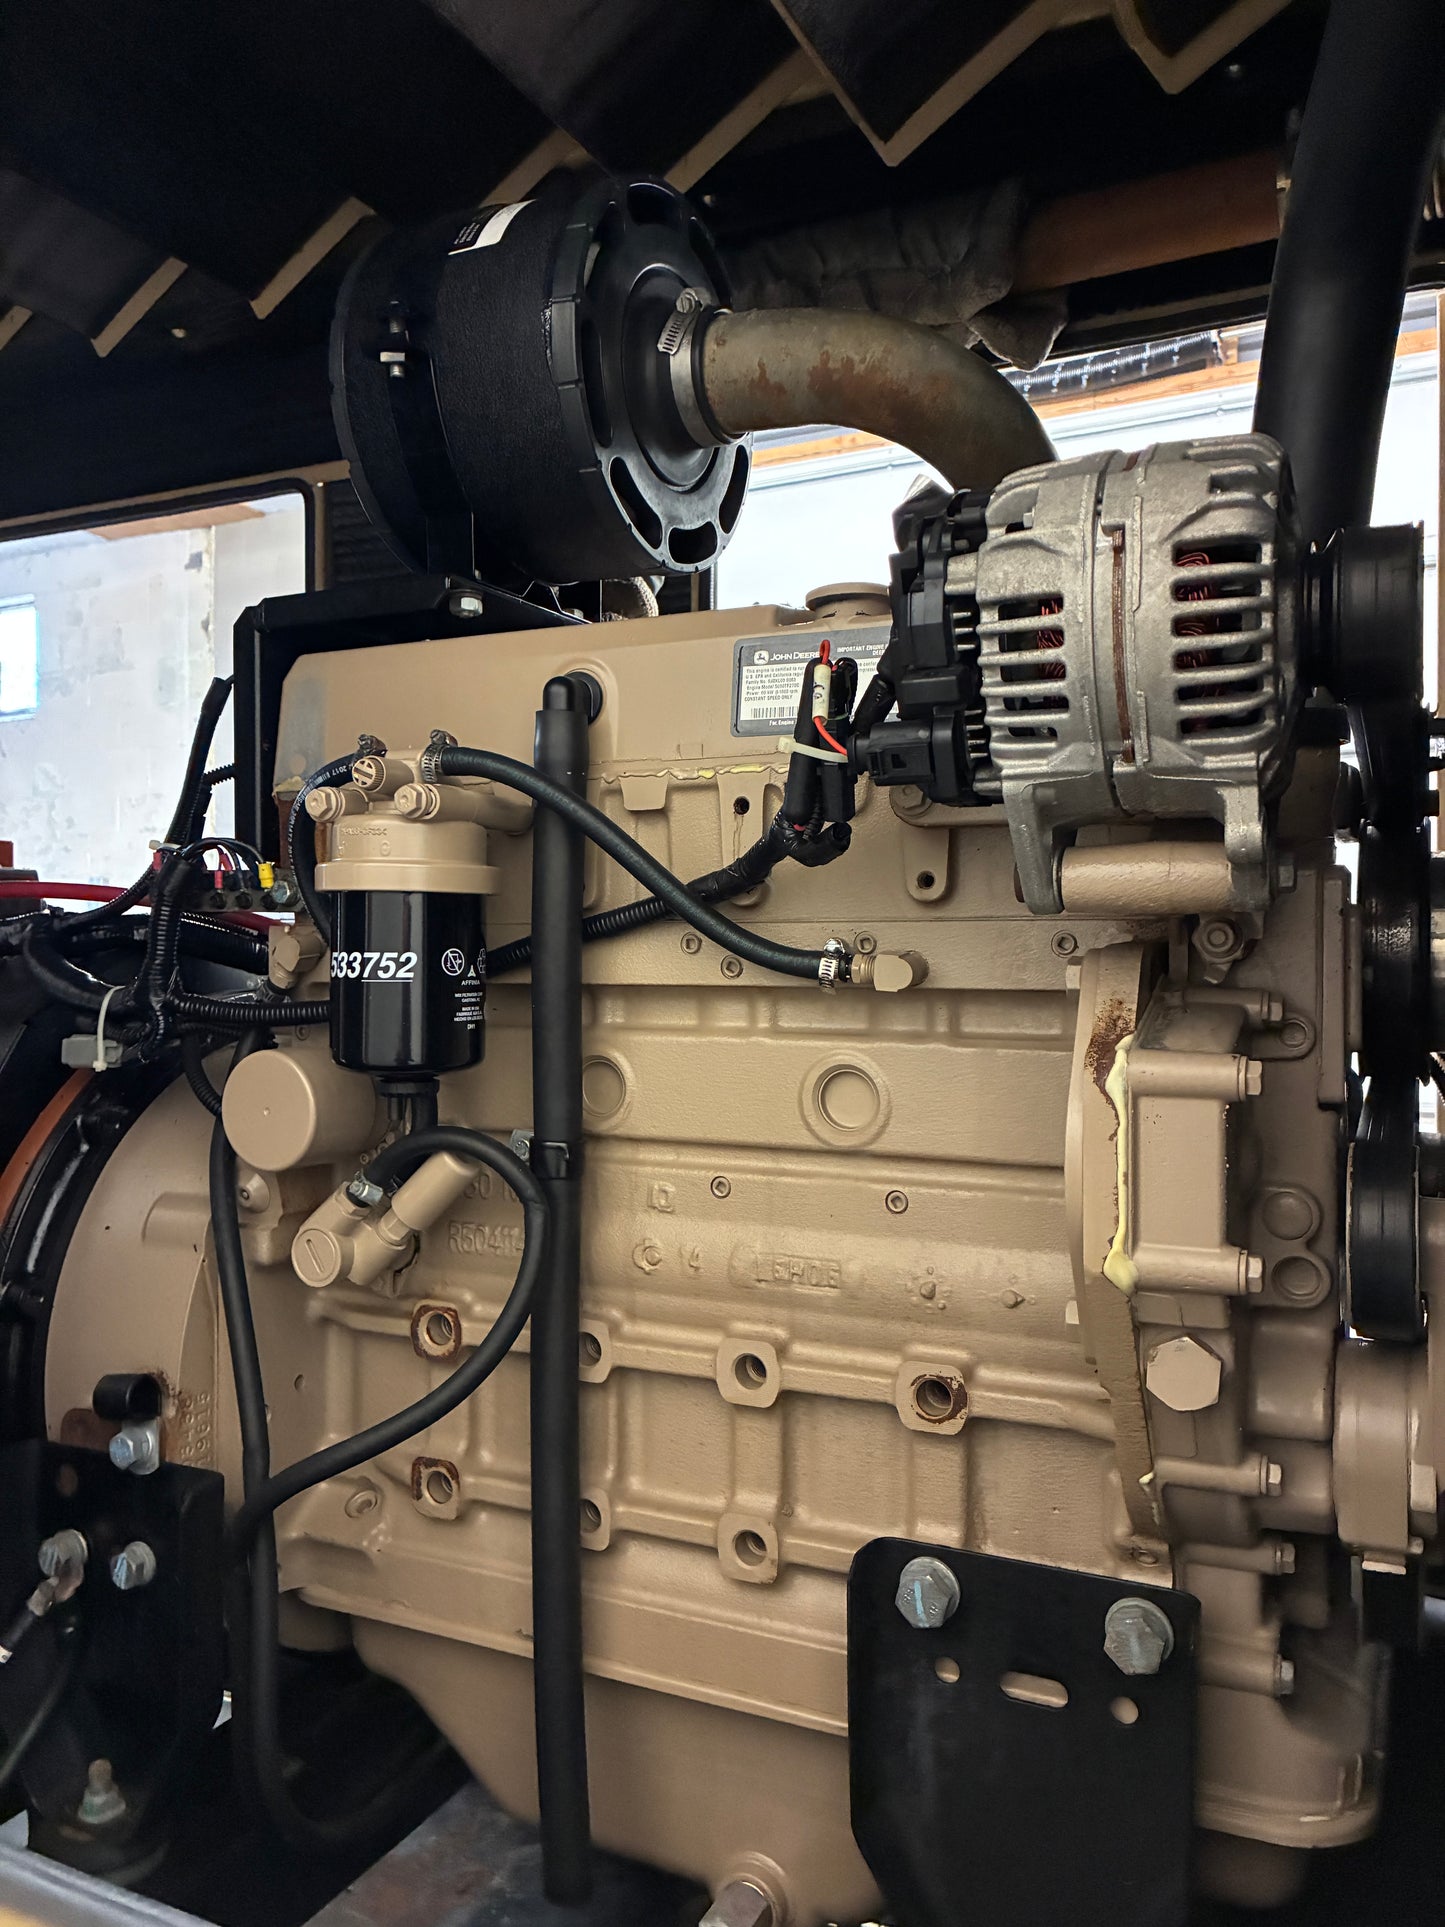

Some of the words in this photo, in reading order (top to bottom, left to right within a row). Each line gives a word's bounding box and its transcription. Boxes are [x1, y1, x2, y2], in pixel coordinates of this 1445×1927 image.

[770, 652, 792, 660] JOHN
[793, 651, 820, 659] DEERE
[330, 952, 418, 979] 533752
